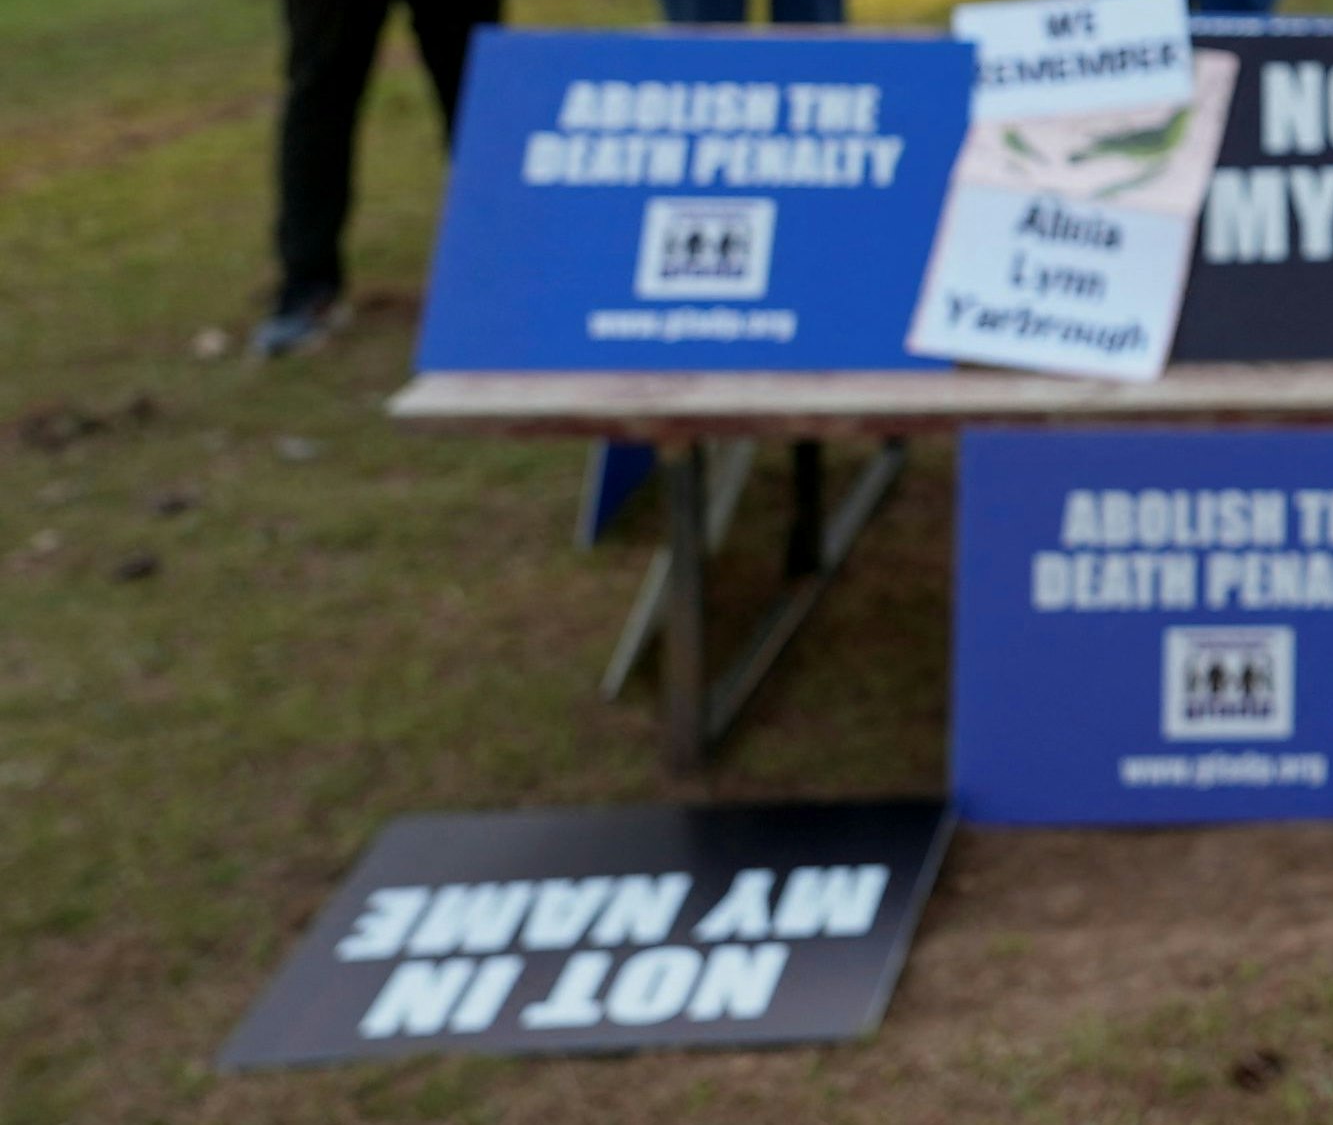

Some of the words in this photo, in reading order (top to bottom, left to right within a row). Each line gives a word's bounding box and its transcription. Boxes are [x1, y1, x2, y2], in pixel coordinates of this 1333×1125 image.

[558, 80, 780, 133] ABOLISH
[788, 84, 882, 133] THE
[521, 132, 687, 187] DEATH
[693, 135, 904, 187] PENALTY
[1061, 489, 1287, 548] ABOLISH
[1031, 550, 1199, 611] DEATH
[335, 873, 692, 961] NAME
[692, 865, 890, 942] MY
[358, 955, 526, 1038] IN
[520, 942, 791, 1029] NOT
